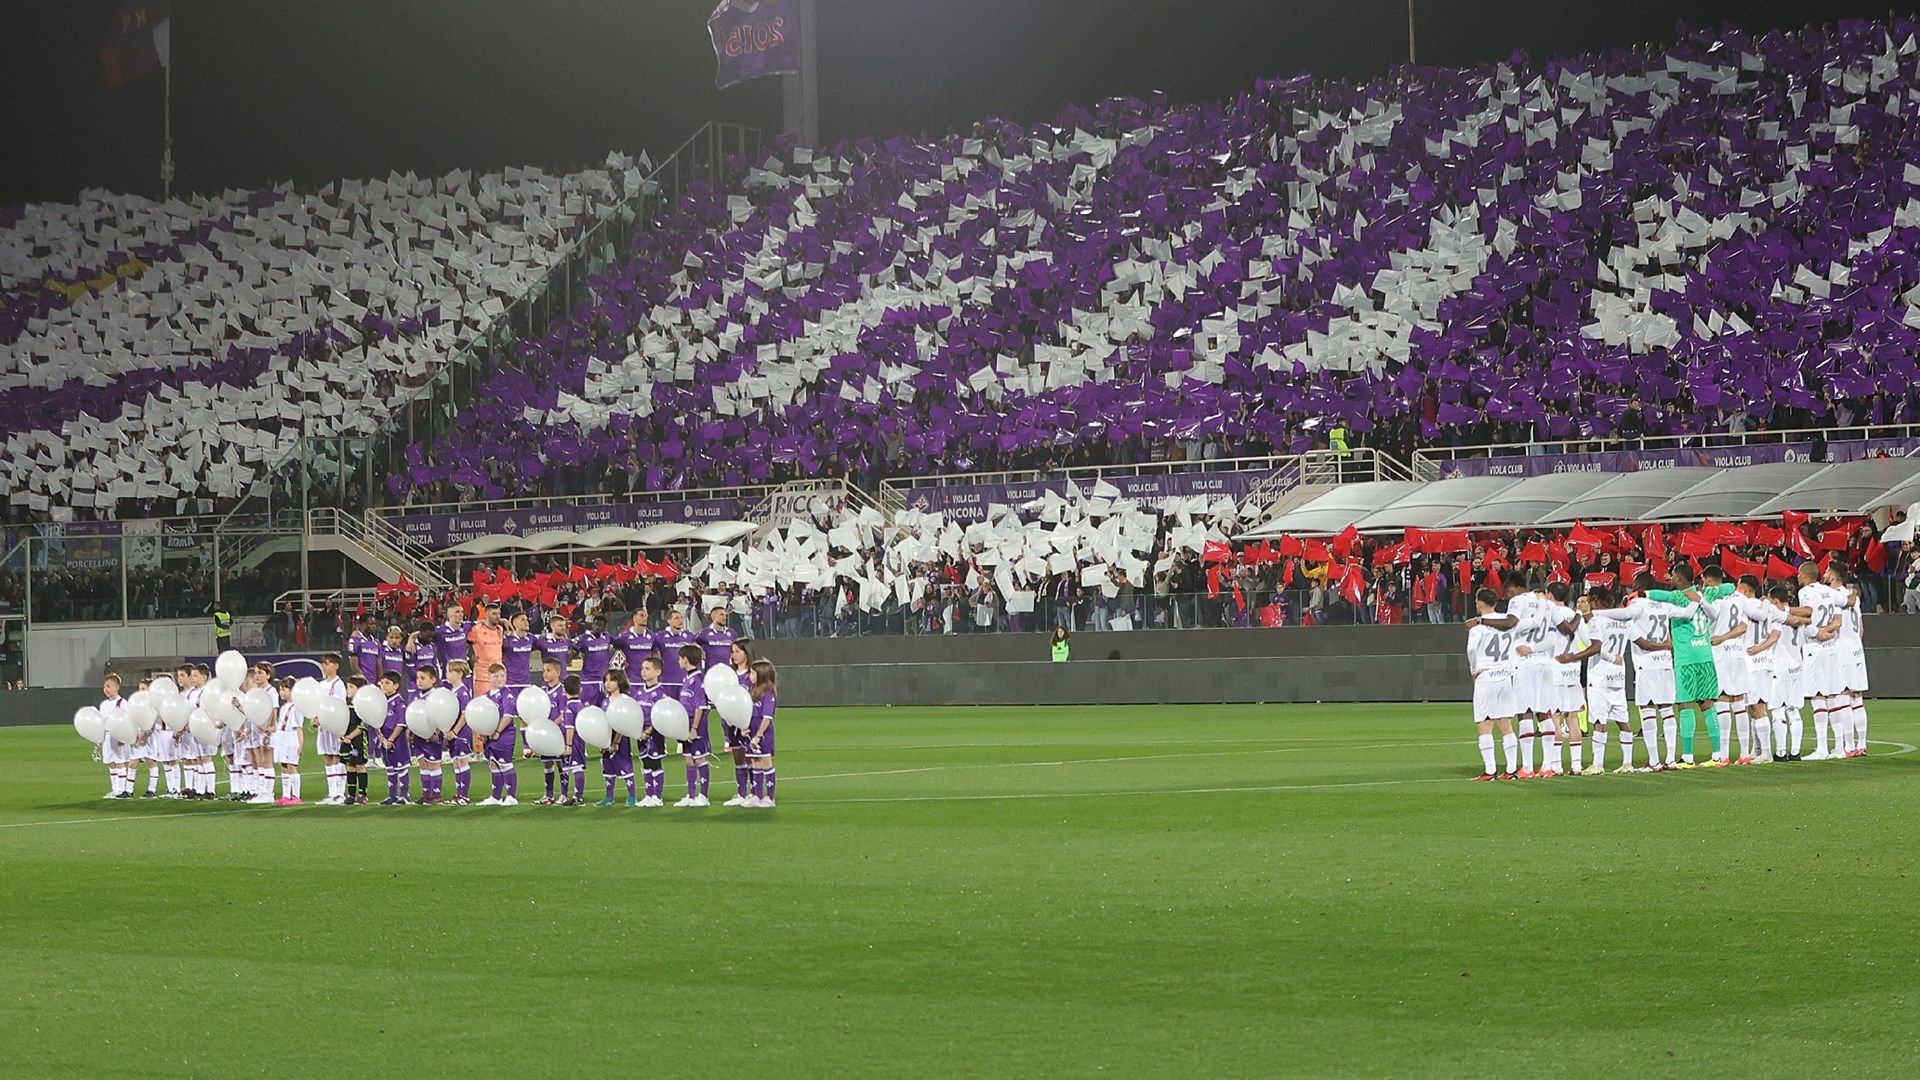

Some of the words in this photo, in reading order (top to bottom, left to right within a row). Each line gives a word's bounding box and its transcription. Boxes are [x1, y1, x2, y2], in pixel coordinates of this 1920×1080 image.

[1889, 447, 1904, 457] CLUB
[1638, 461, 1657, 470] VIOLA
[1658, 460, 1675, 469] CLUB
[1714, 457, 1734, 466] VIOLA
[1734, 455, 1752, 466] CLUB
[1490, 466, 1507, 475] VIOLA
[1508, 464, 1523, 474] CLUB
[1568, 464, 1586, 472] VIOLA
[1587, 463, 1602, 472] CLUB
[1128, 484, 1144, 493] VIOLA
[1144, 482, 1159, 492] CLUB
[1192, 481, 1207, 490] VIOLA
[1208, 480, 1223, 489] CLUB
[952, 495, 967, 503] VIOLA
[968, 494, 981, 503] CLUB
[1007, 490, 1022, 499] VIOLA
[1023, 489, 1036, 498] CLUB
[943, 507, 984, 519] ANCONA
[537, 515, 552, 524] VIOLA
[552, 514, 564, 523] CLUB
[406, 523, 419, 532] VIOLA
[420, 522, 432, 531] CLUB
[460, 521, 474, 529] VIOLA
[475, 520, 487, 528] CLUB
[66, 559, 118, 569] PORCELLINO
[1647, 614, 1668, 643] 23
[1484, 633, 1512, 662] 42
